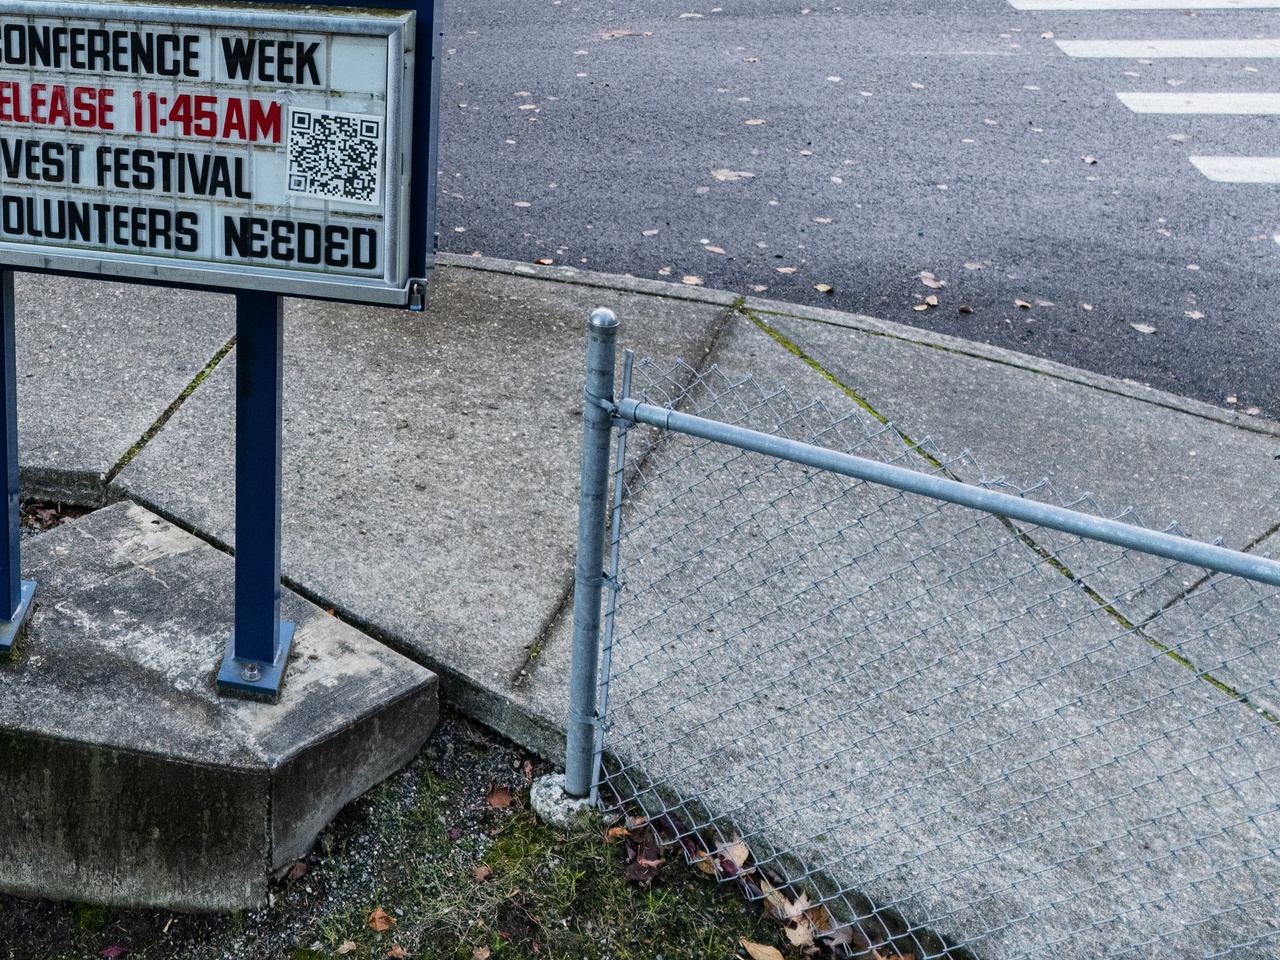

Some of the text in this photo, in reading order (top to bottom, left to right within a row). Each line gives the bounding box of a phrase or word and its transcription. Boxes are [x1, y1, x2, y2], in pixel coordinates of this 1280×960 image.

[221, 37, 321, 85] WEEK
[96, 146, 252, 199] FESTIVAL
[224, 216, 377, 270] NEEDED
